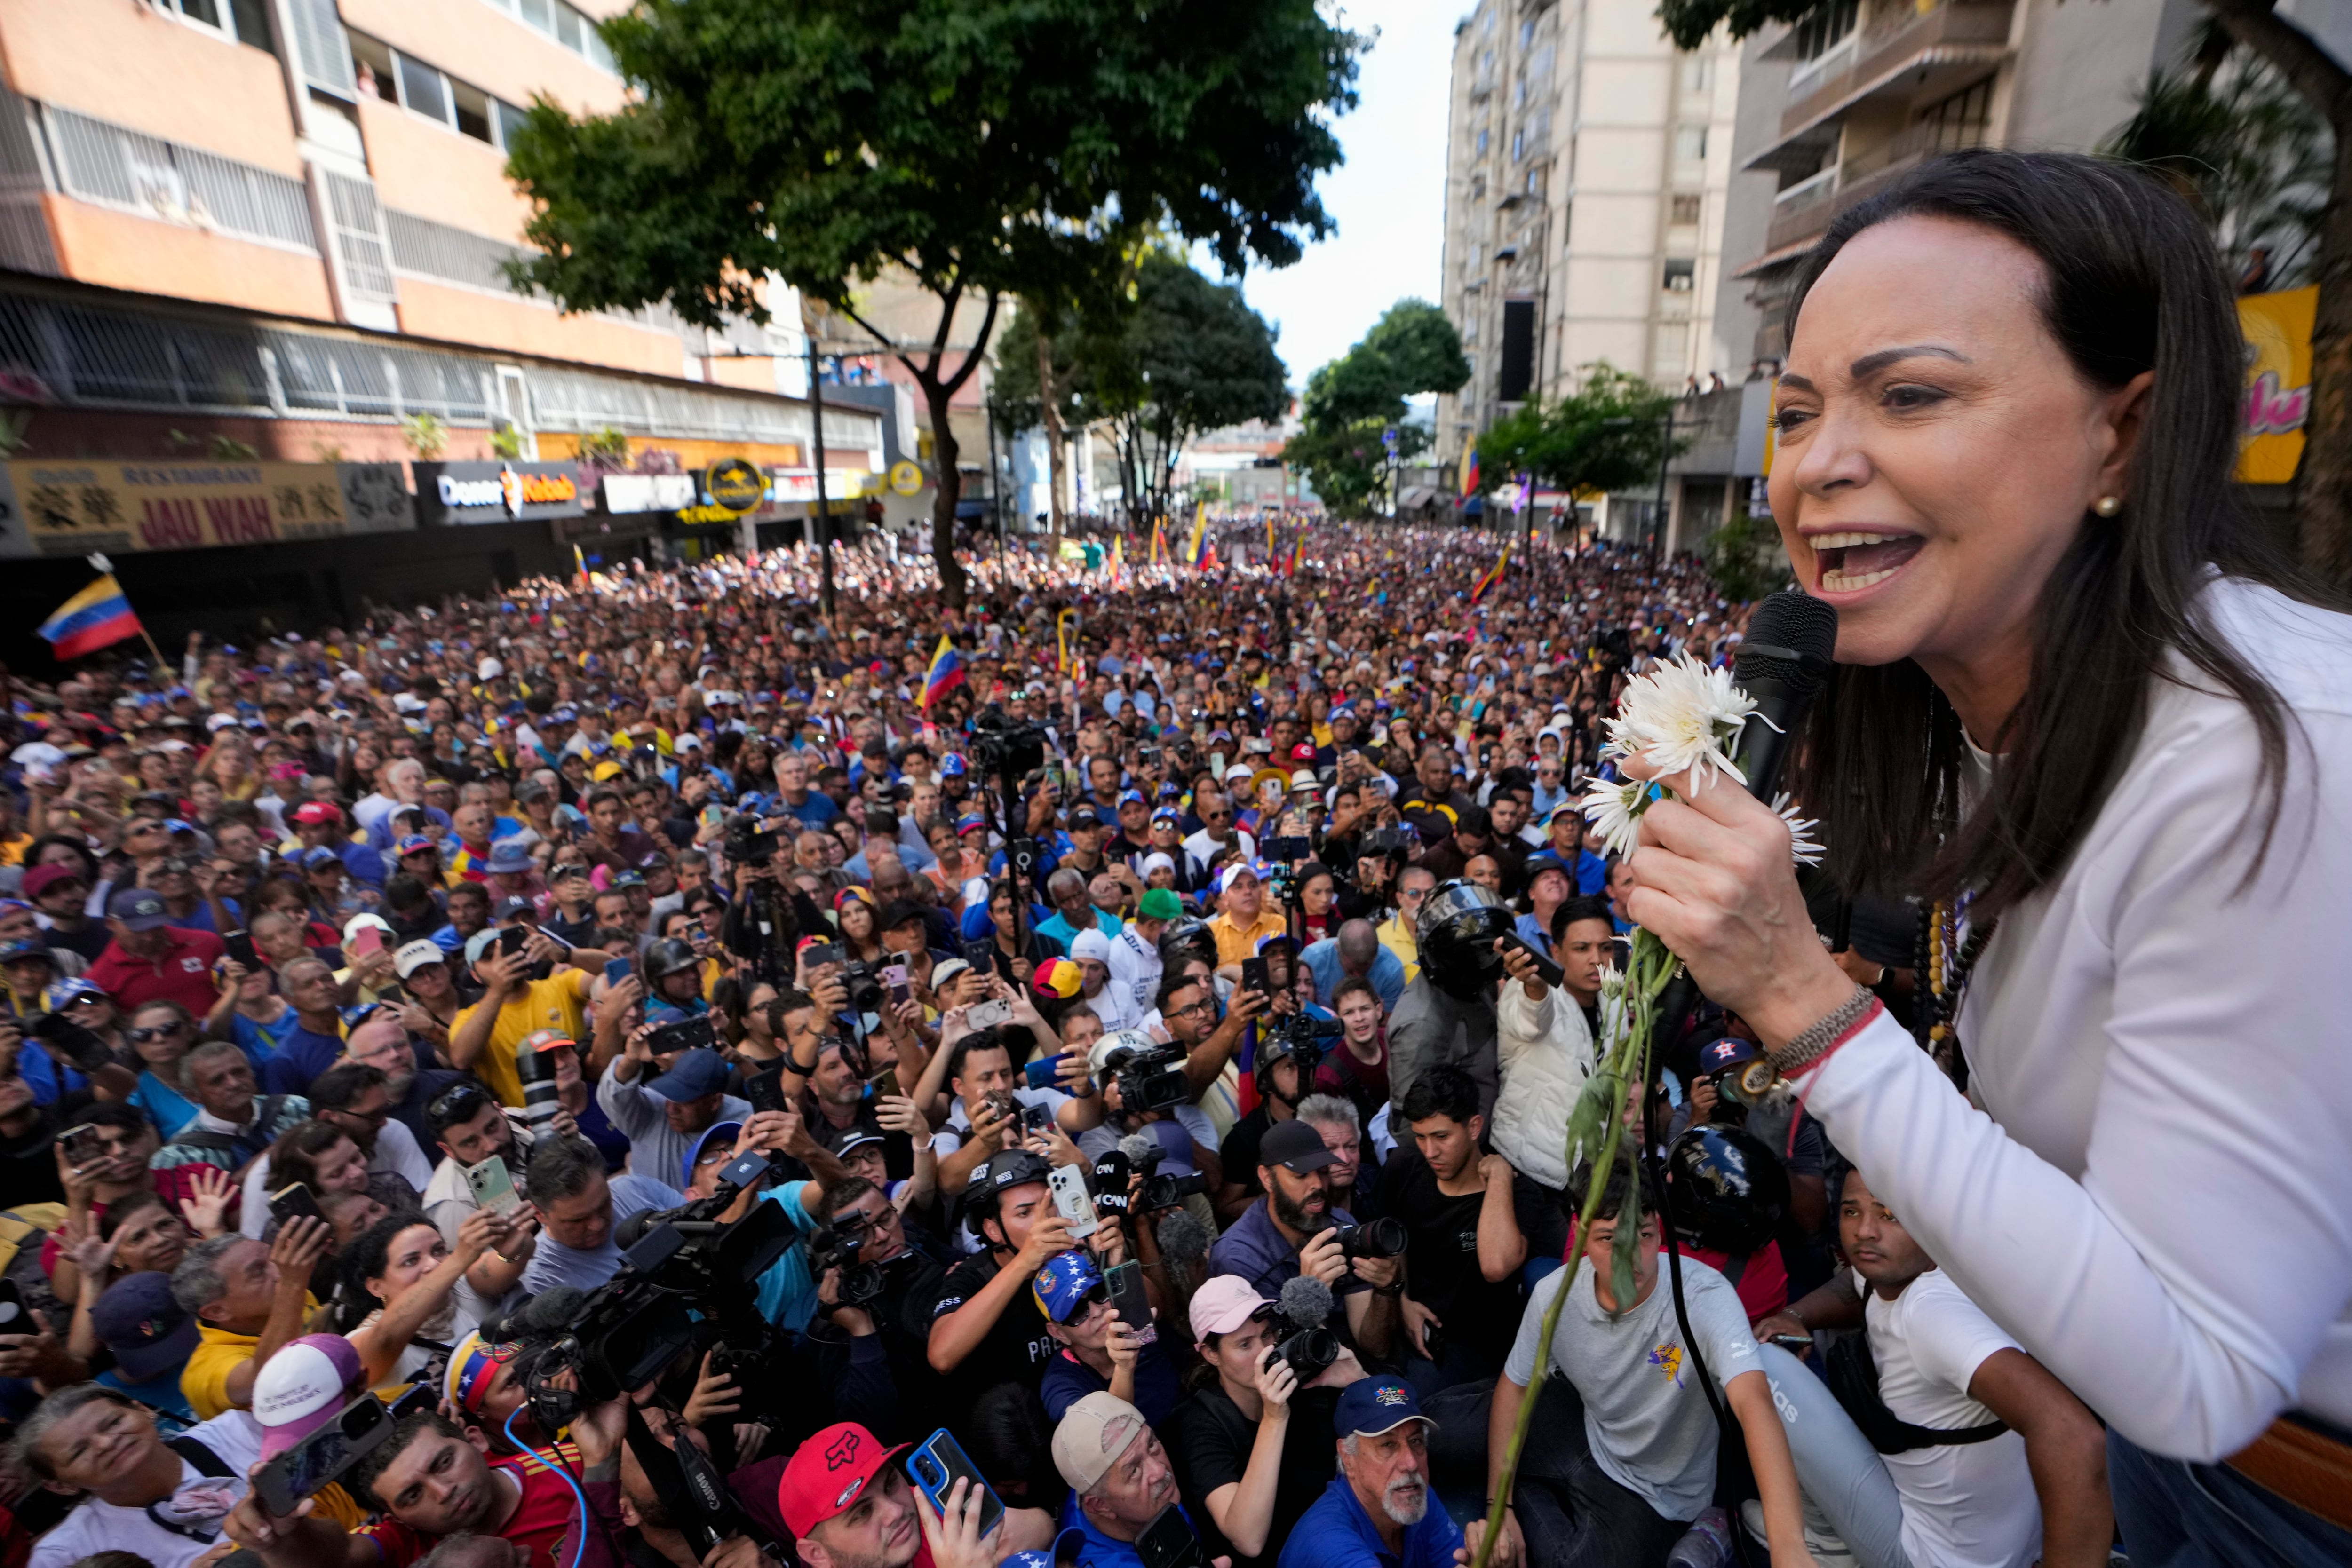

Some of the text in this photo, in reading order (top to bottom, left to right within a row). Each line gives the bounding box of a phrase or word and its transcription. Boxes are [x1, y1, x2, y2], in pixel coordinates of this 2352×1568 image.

[202, 496, 277, 544] WAH
[1096, 1164, 1115, 1175] CNN
[995, 1170, 1013, 1185] PRESS
[1102, 1194, 1128, 1207] CNN
[695, 1472, 721, 1510] Canon
